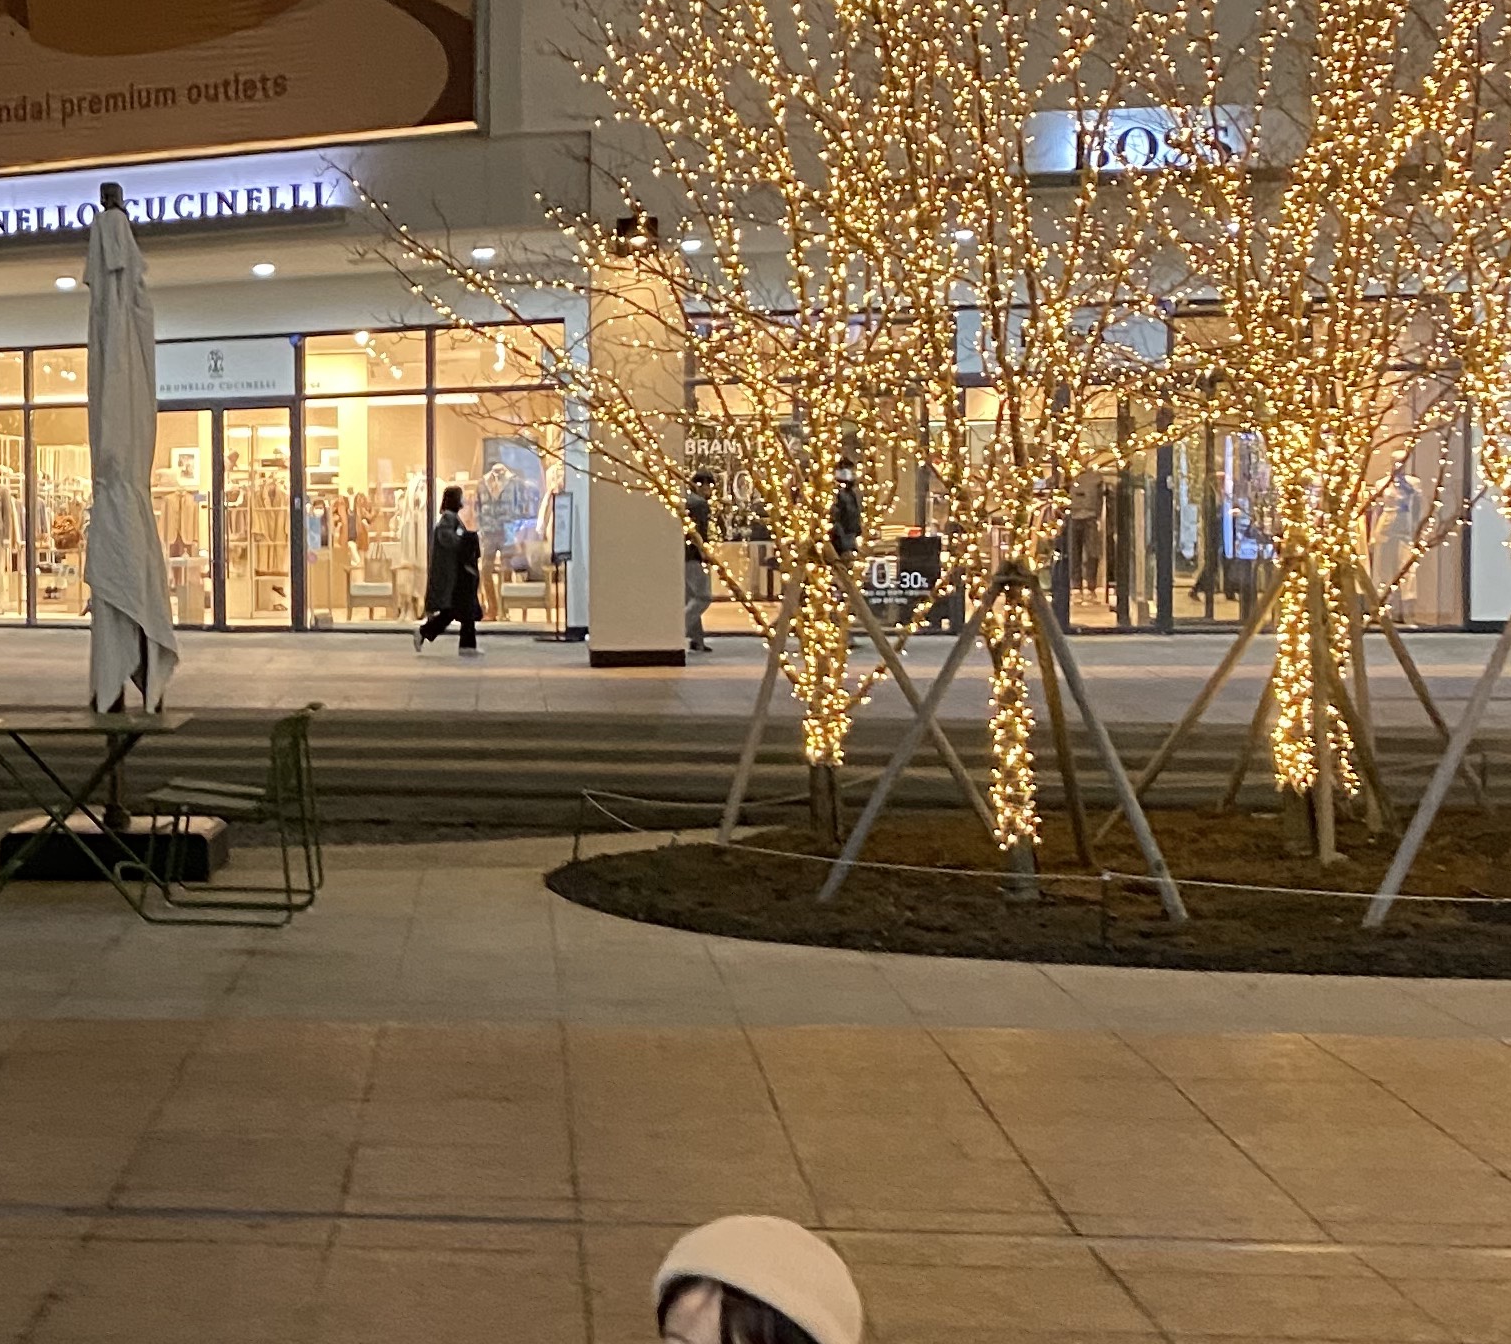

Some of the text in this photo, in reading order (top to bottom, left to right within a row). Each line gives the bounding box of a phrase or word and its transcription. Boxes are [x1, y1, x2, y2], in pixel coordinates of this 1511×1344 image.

[60, 82, 177, 128] premium
[186, 72, 289, 105] outlets
[159, 380, 277, 393] BRUNELLO CUCINELLI
